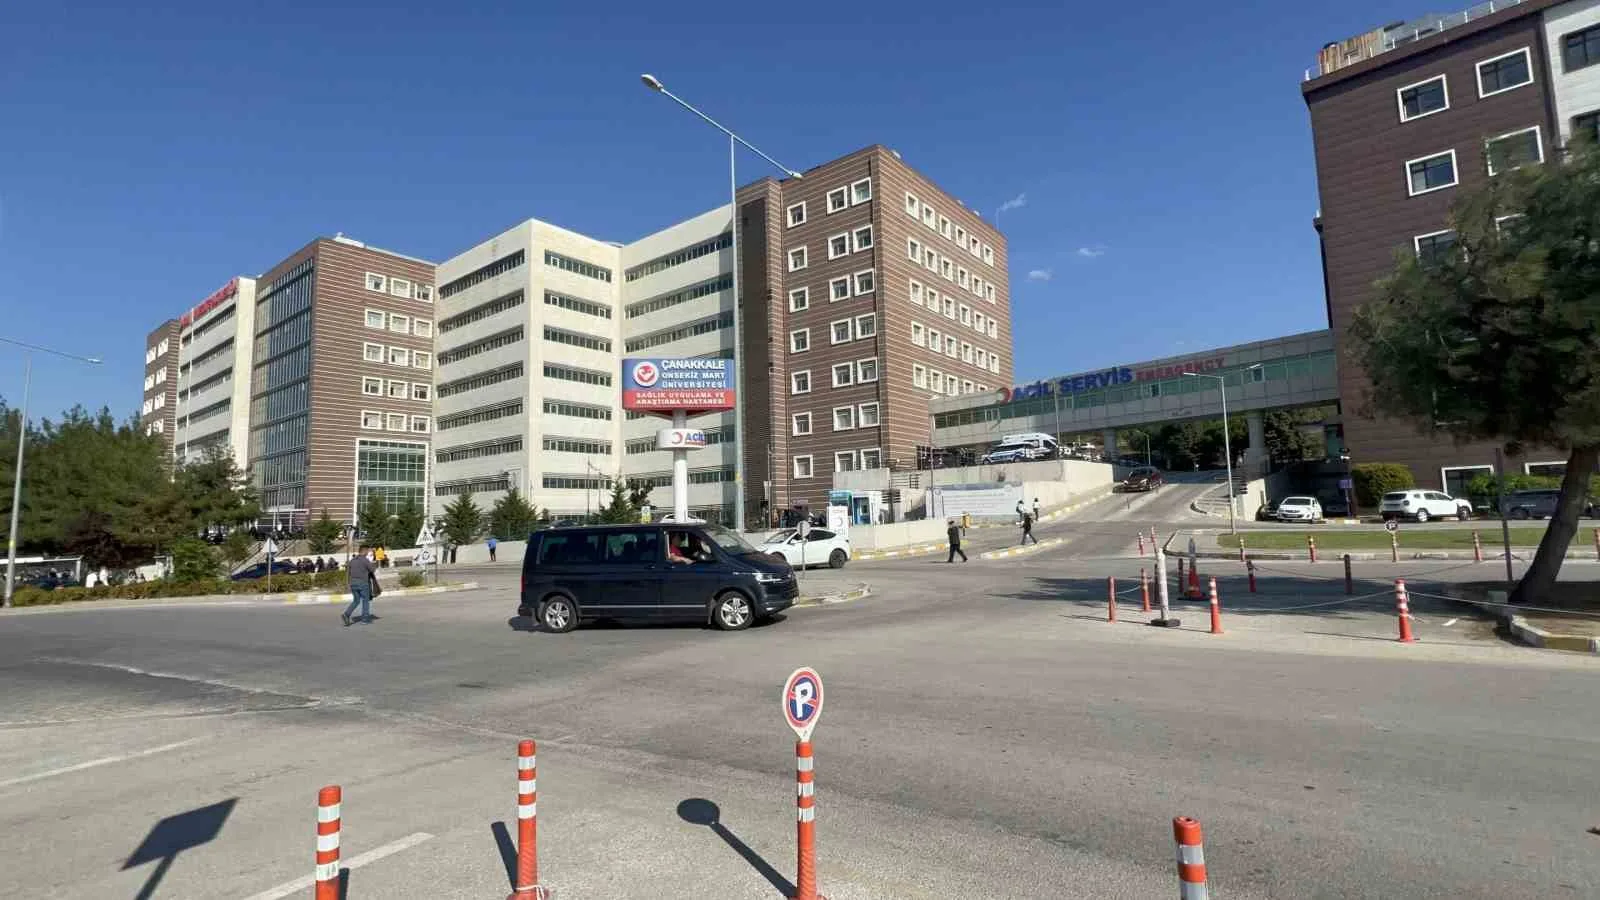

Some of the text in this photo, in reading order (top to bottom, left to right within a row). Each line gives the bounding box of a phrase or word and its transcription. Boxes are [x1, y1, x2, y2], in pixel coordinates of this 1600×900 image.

[661, 359, 725, 370] ÇANAKKALE
[661, 371, 726, 379] ONSEKİZ MART
[1059, 367, 1132, 393] SERVİS
[662, 380, 726, 388] ÜNİVERSİTESİ
[795, 681, 813, 718] P
